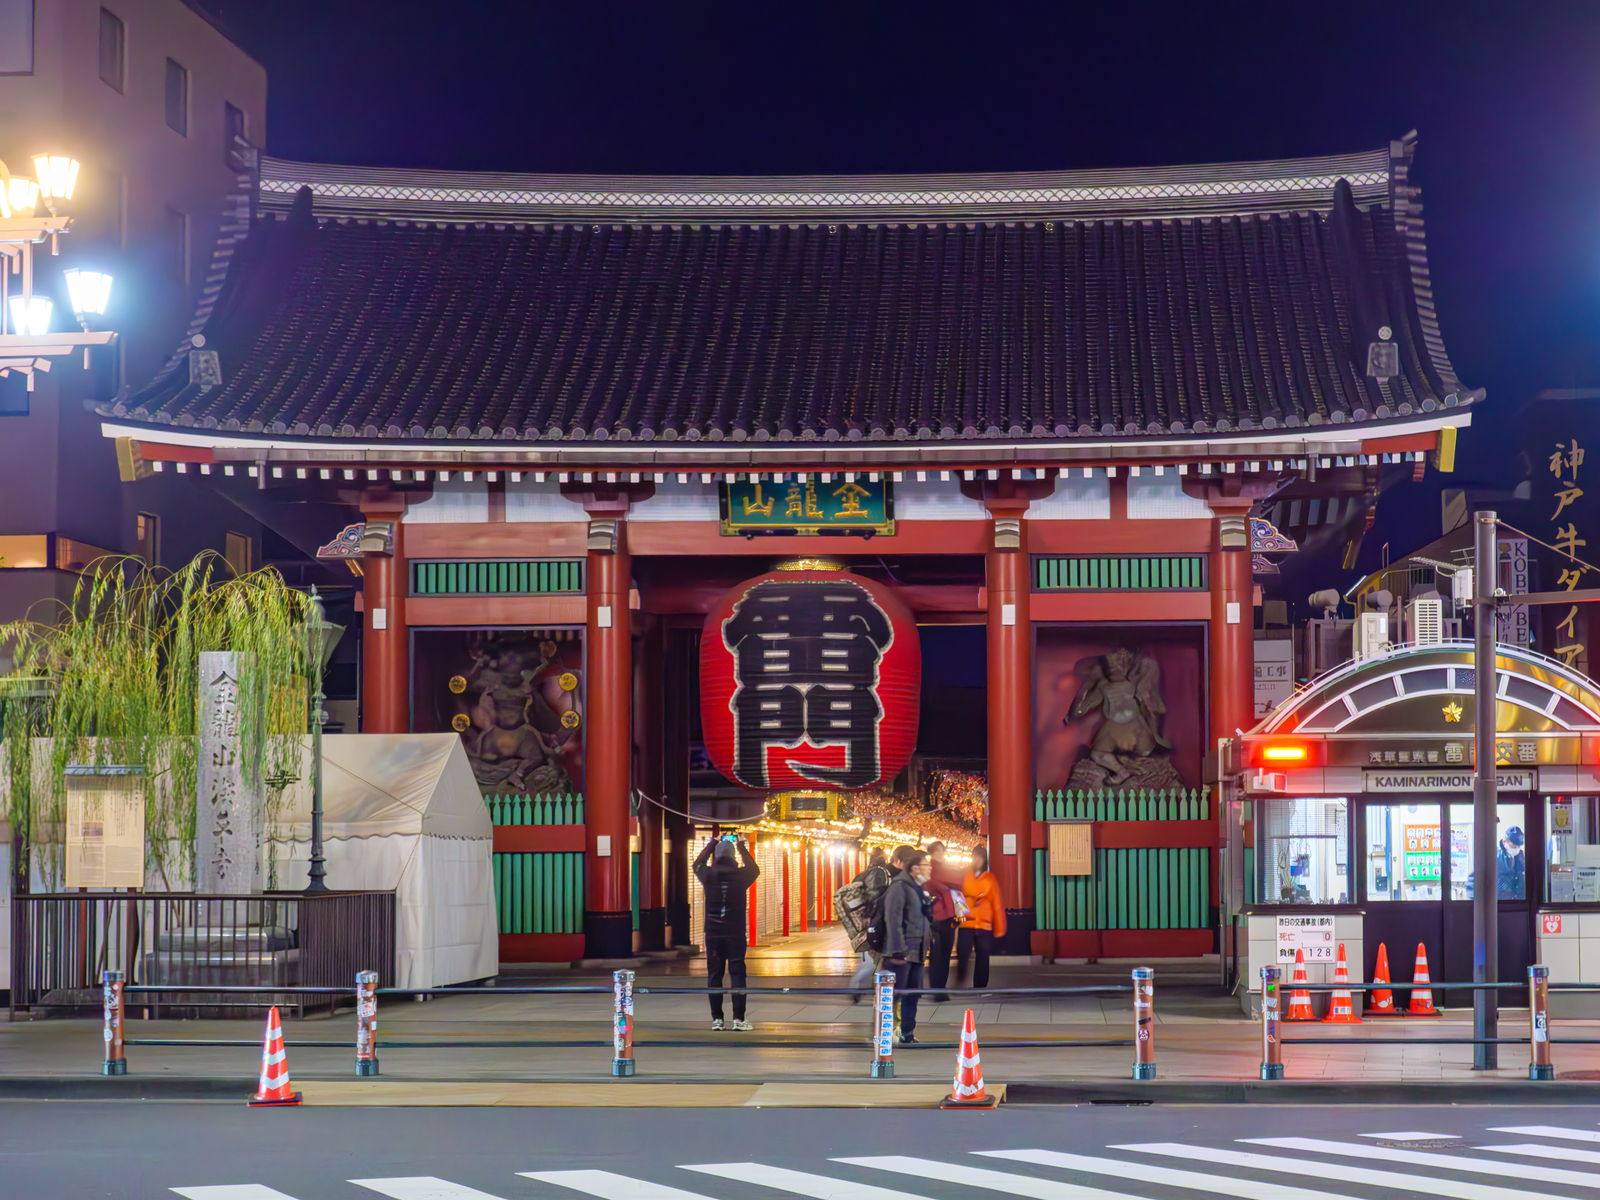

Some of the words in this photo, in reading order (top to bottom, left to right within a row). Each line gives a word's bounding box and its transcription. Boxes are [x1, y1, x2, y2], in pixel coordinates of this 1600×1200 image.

[721, 579, 895, 788] 雷門
[1445, 742, 1538, 764] 雷交番
[1375, 776, 1471, 788] KAMINARIMON
[1496, 775, 1523, 787] BAN
[1544, 914, 1561, 922] AED
[1324, 932, 1331, 942] 0
